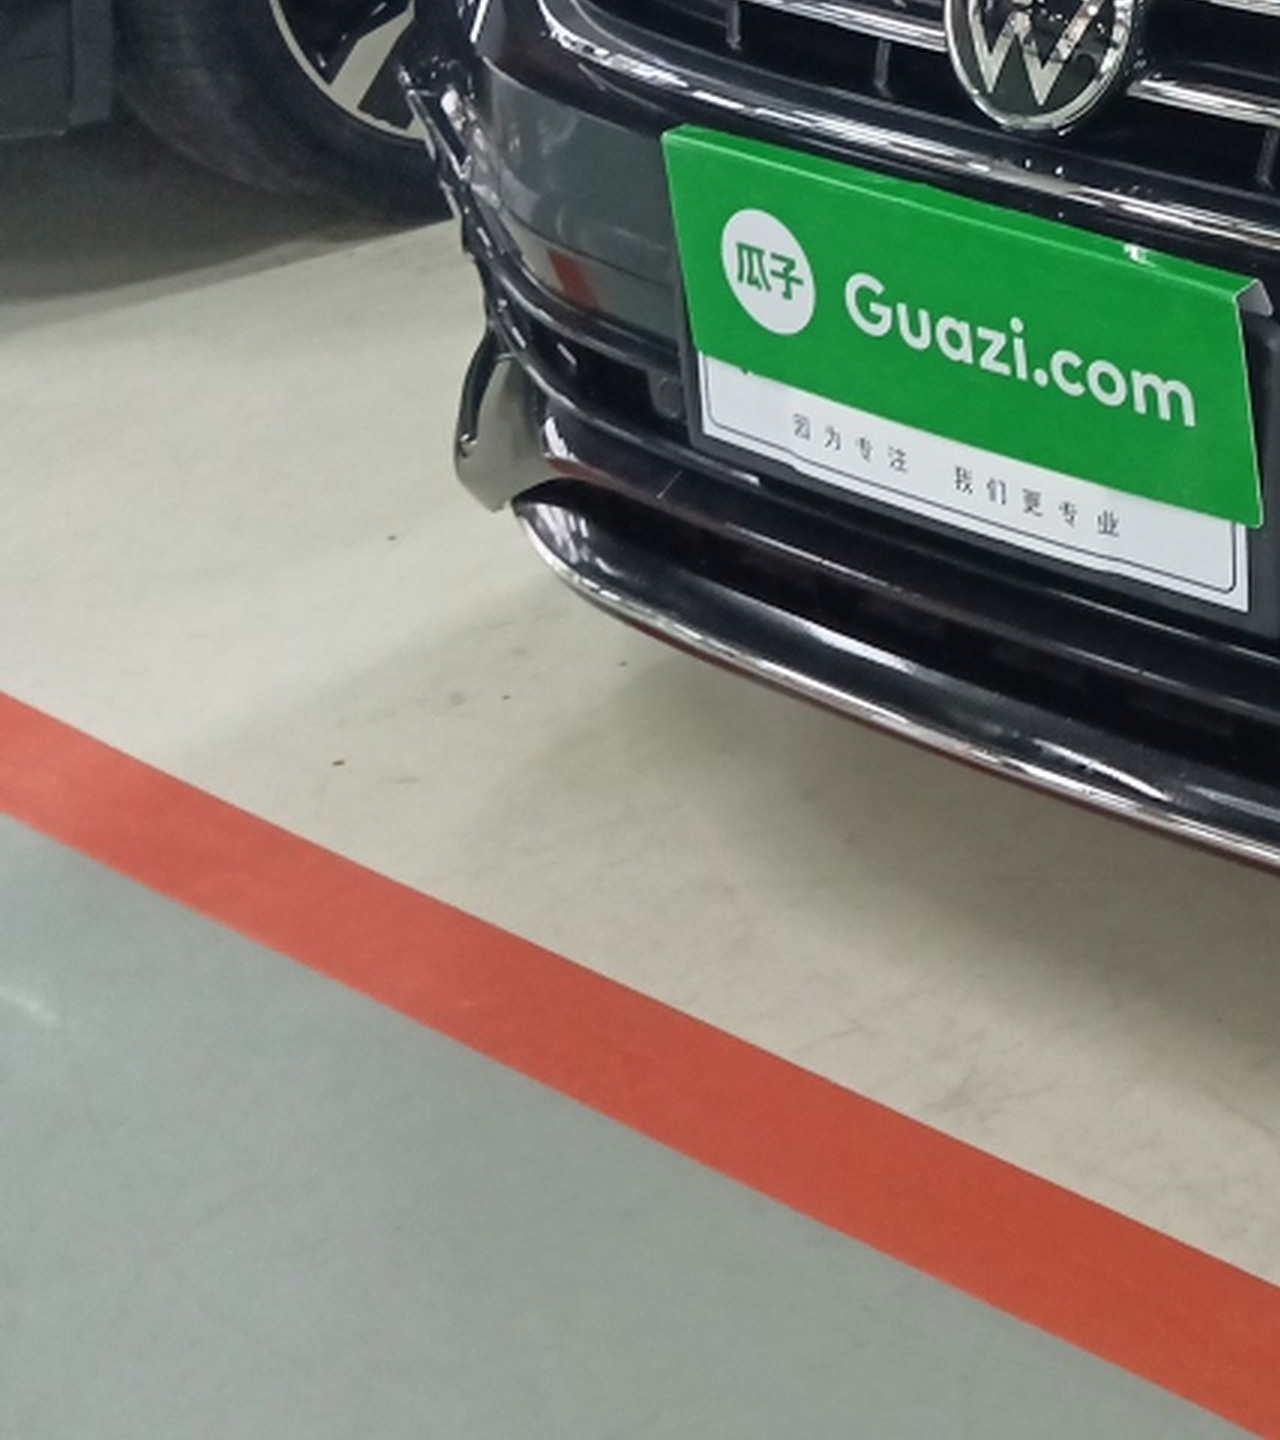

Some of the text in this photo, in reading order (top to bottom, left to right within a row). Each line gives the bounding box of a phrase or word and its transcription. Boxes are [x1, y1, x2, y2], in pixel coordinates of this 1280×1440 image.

[736, 242, 1196, 427] 瓜子 Guazi.com
[793, 413, 1120, 537] 因为专注 我们更专业
